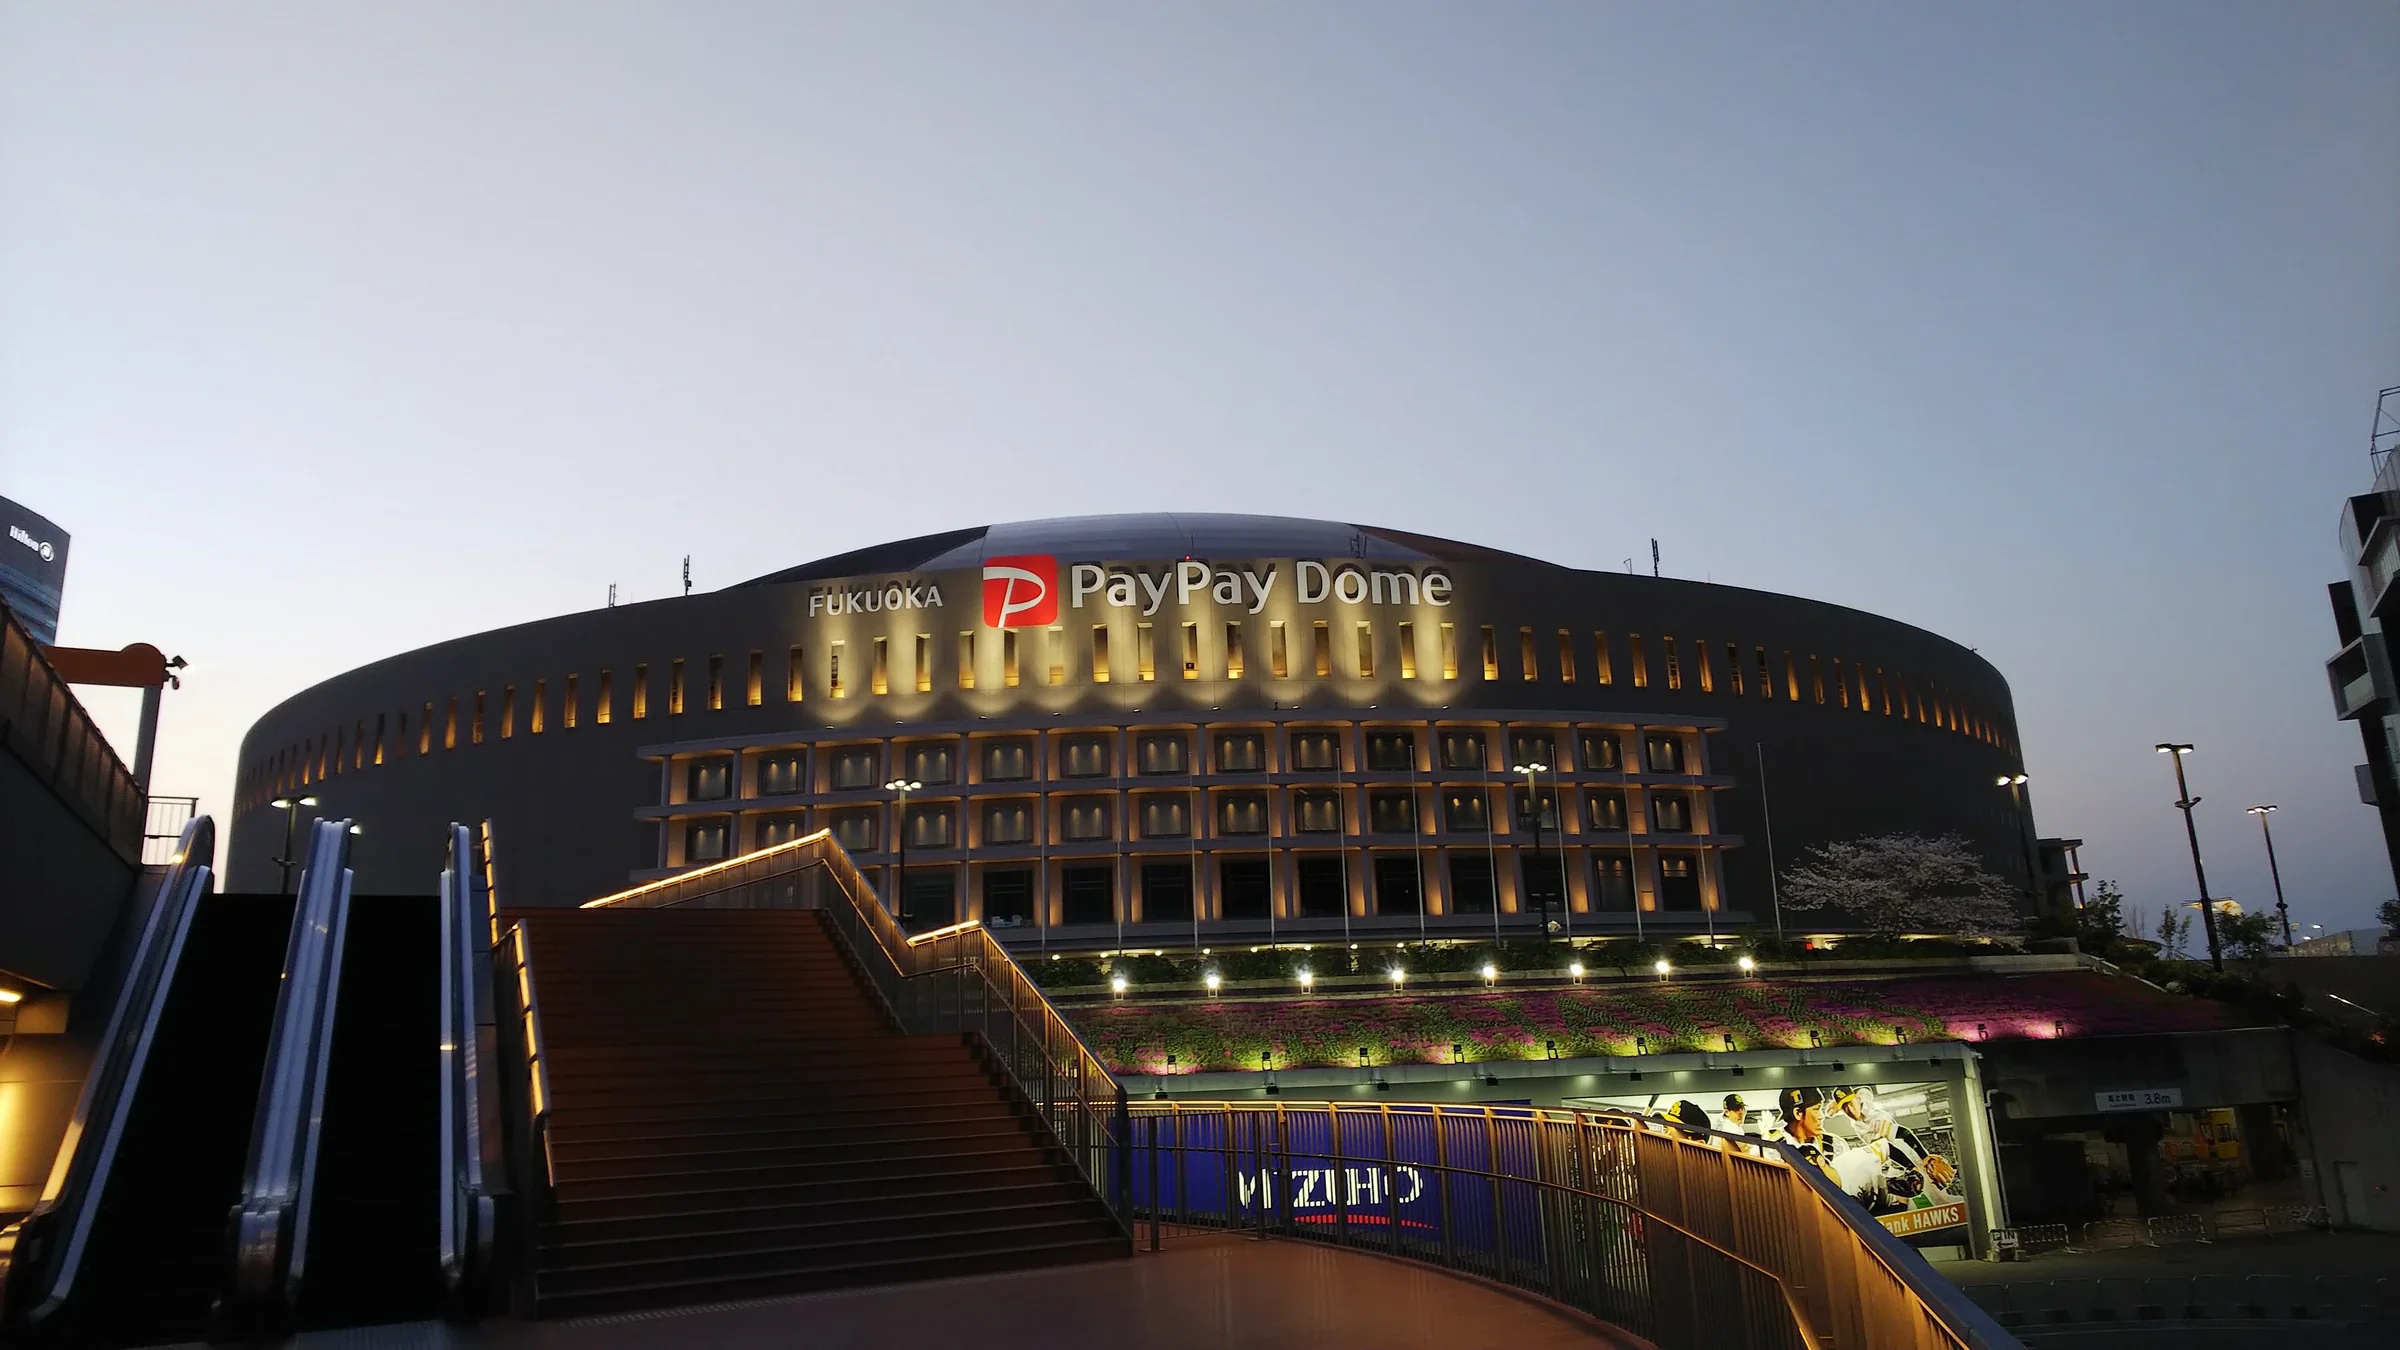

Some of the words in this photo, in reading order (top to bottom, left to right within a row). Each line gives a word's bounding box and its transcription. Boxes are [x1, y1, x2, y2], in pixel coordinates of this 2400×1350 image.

[809, 586, 944, 618] FUKUOKA
[1071, 561, 1278, 616] PayPay
[1296, 561, 1453, 607] Dome
[2144, 1092, 2171, 1105] 3.8m
[1881, 1217, 1910, 1234] ank
[1913, 1206, 1960, 1230] HAWKS
[2004, 1230, 2015, 1240] IN
